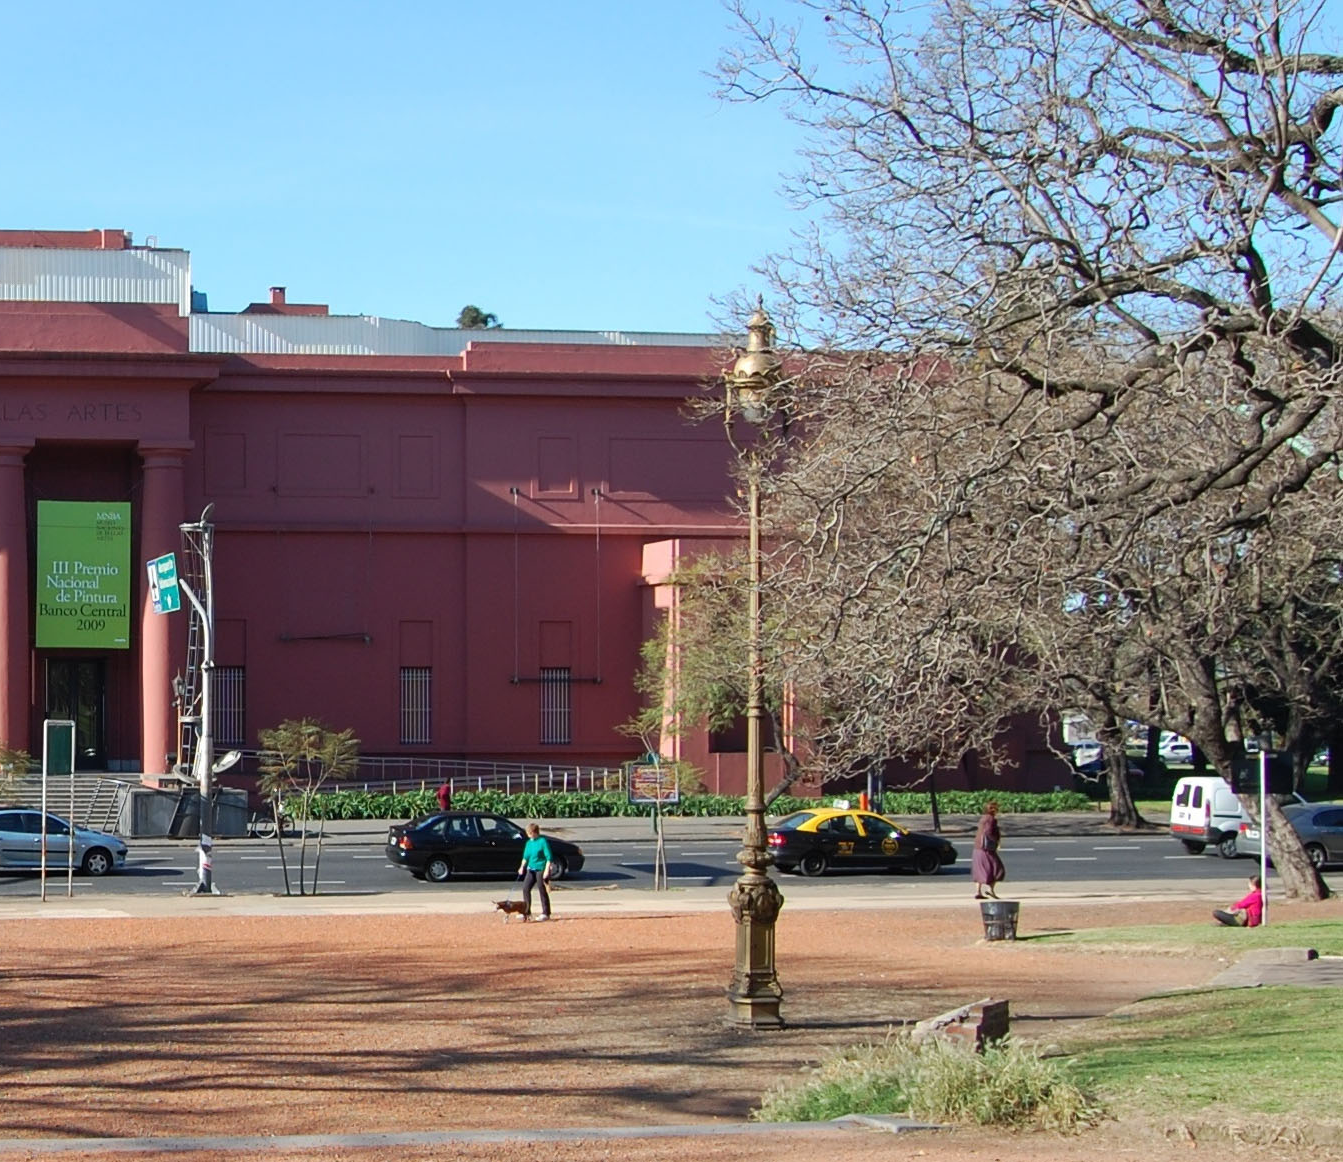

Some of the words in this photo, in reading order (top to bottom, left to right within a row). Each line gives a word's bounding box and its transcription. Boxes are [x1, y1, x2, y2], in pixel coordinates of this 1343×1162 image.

[67, 403, 143, 422] ARTES
[52, 561, 69, 574] III
[73, 561, 119, 575] Premio
[46, 575, 99, 588] Nacional
[56, 589, 71, 602] de
[73, 590, 117, 604] Pintura
[39, 603, 78, 617] Banco
[80, 603, 126, 617] Central
[76, 619, 106, 631] 2009
